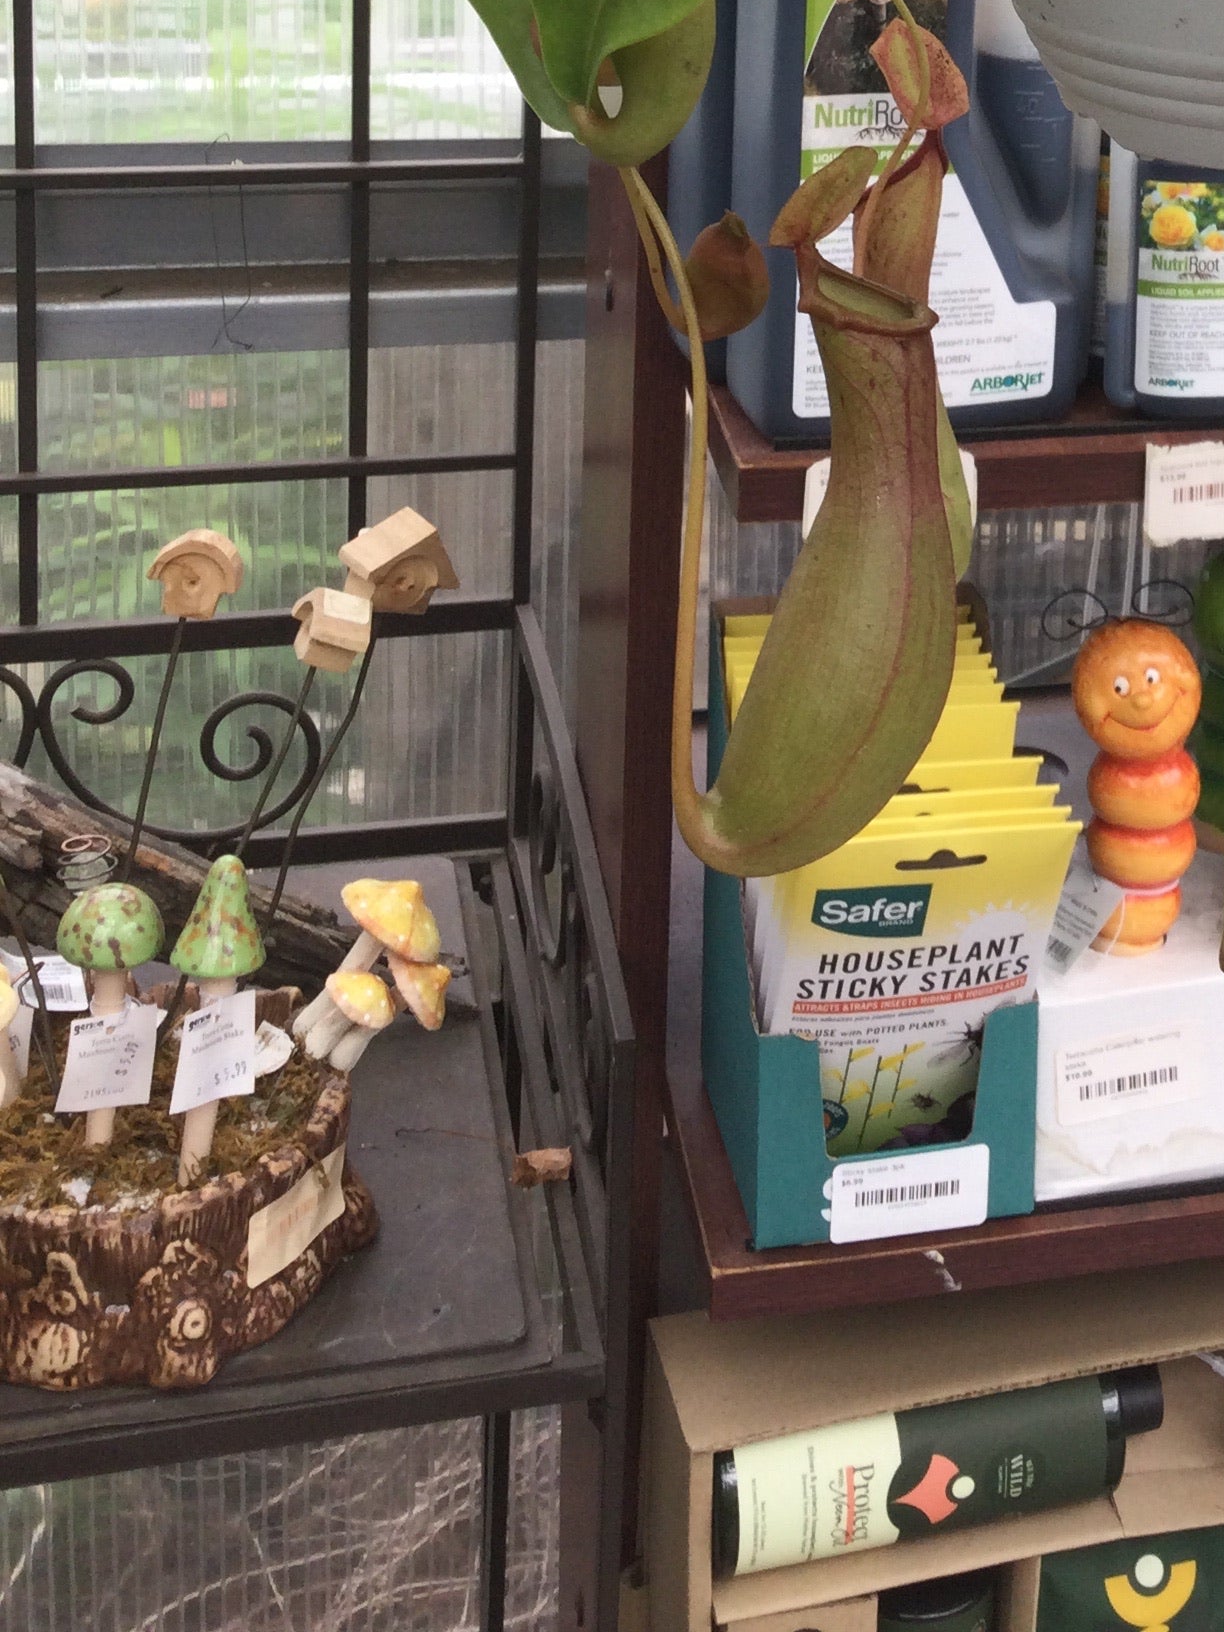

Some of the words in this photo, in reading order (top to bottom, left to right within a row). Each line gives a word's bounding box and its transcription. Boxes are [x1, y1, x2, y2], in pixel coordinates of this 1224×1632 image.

[815, 99, 907, 129] NutriRo
[1151, 254, 1220, 274] NutriRoot
[1151, 287, 1177, 297] LIQUID
[1178, 288, 1194, 297] SOIL
[1149, 329, 1167, 337] KEEP
[820, 898, 924, 924] Safer
[878, 919, 914, 928] BRAND
[818, 934, 1025, 975] HOUSEPLANT
[796, 974, 908, 1000] STICKY
[919, 955, 1030, 993] STAKES
[794, 1002, 840, 1013] ATTRACTS
[880, 996, 918, 1009] INSECTS
[920, 994, 951, 1004] HIDING
[954, 990, 965, 1000] IN
[815, 1028, 837, 1037] USE
[841, 1028, 863, 1037] with
[866, 1023, 906, 1035] POTTED
[909, 1019, 946, 1031] PLANTS
[1009, 1454, 1024, 1498] WILD
[852, 1462, 875, 1543] Protect
